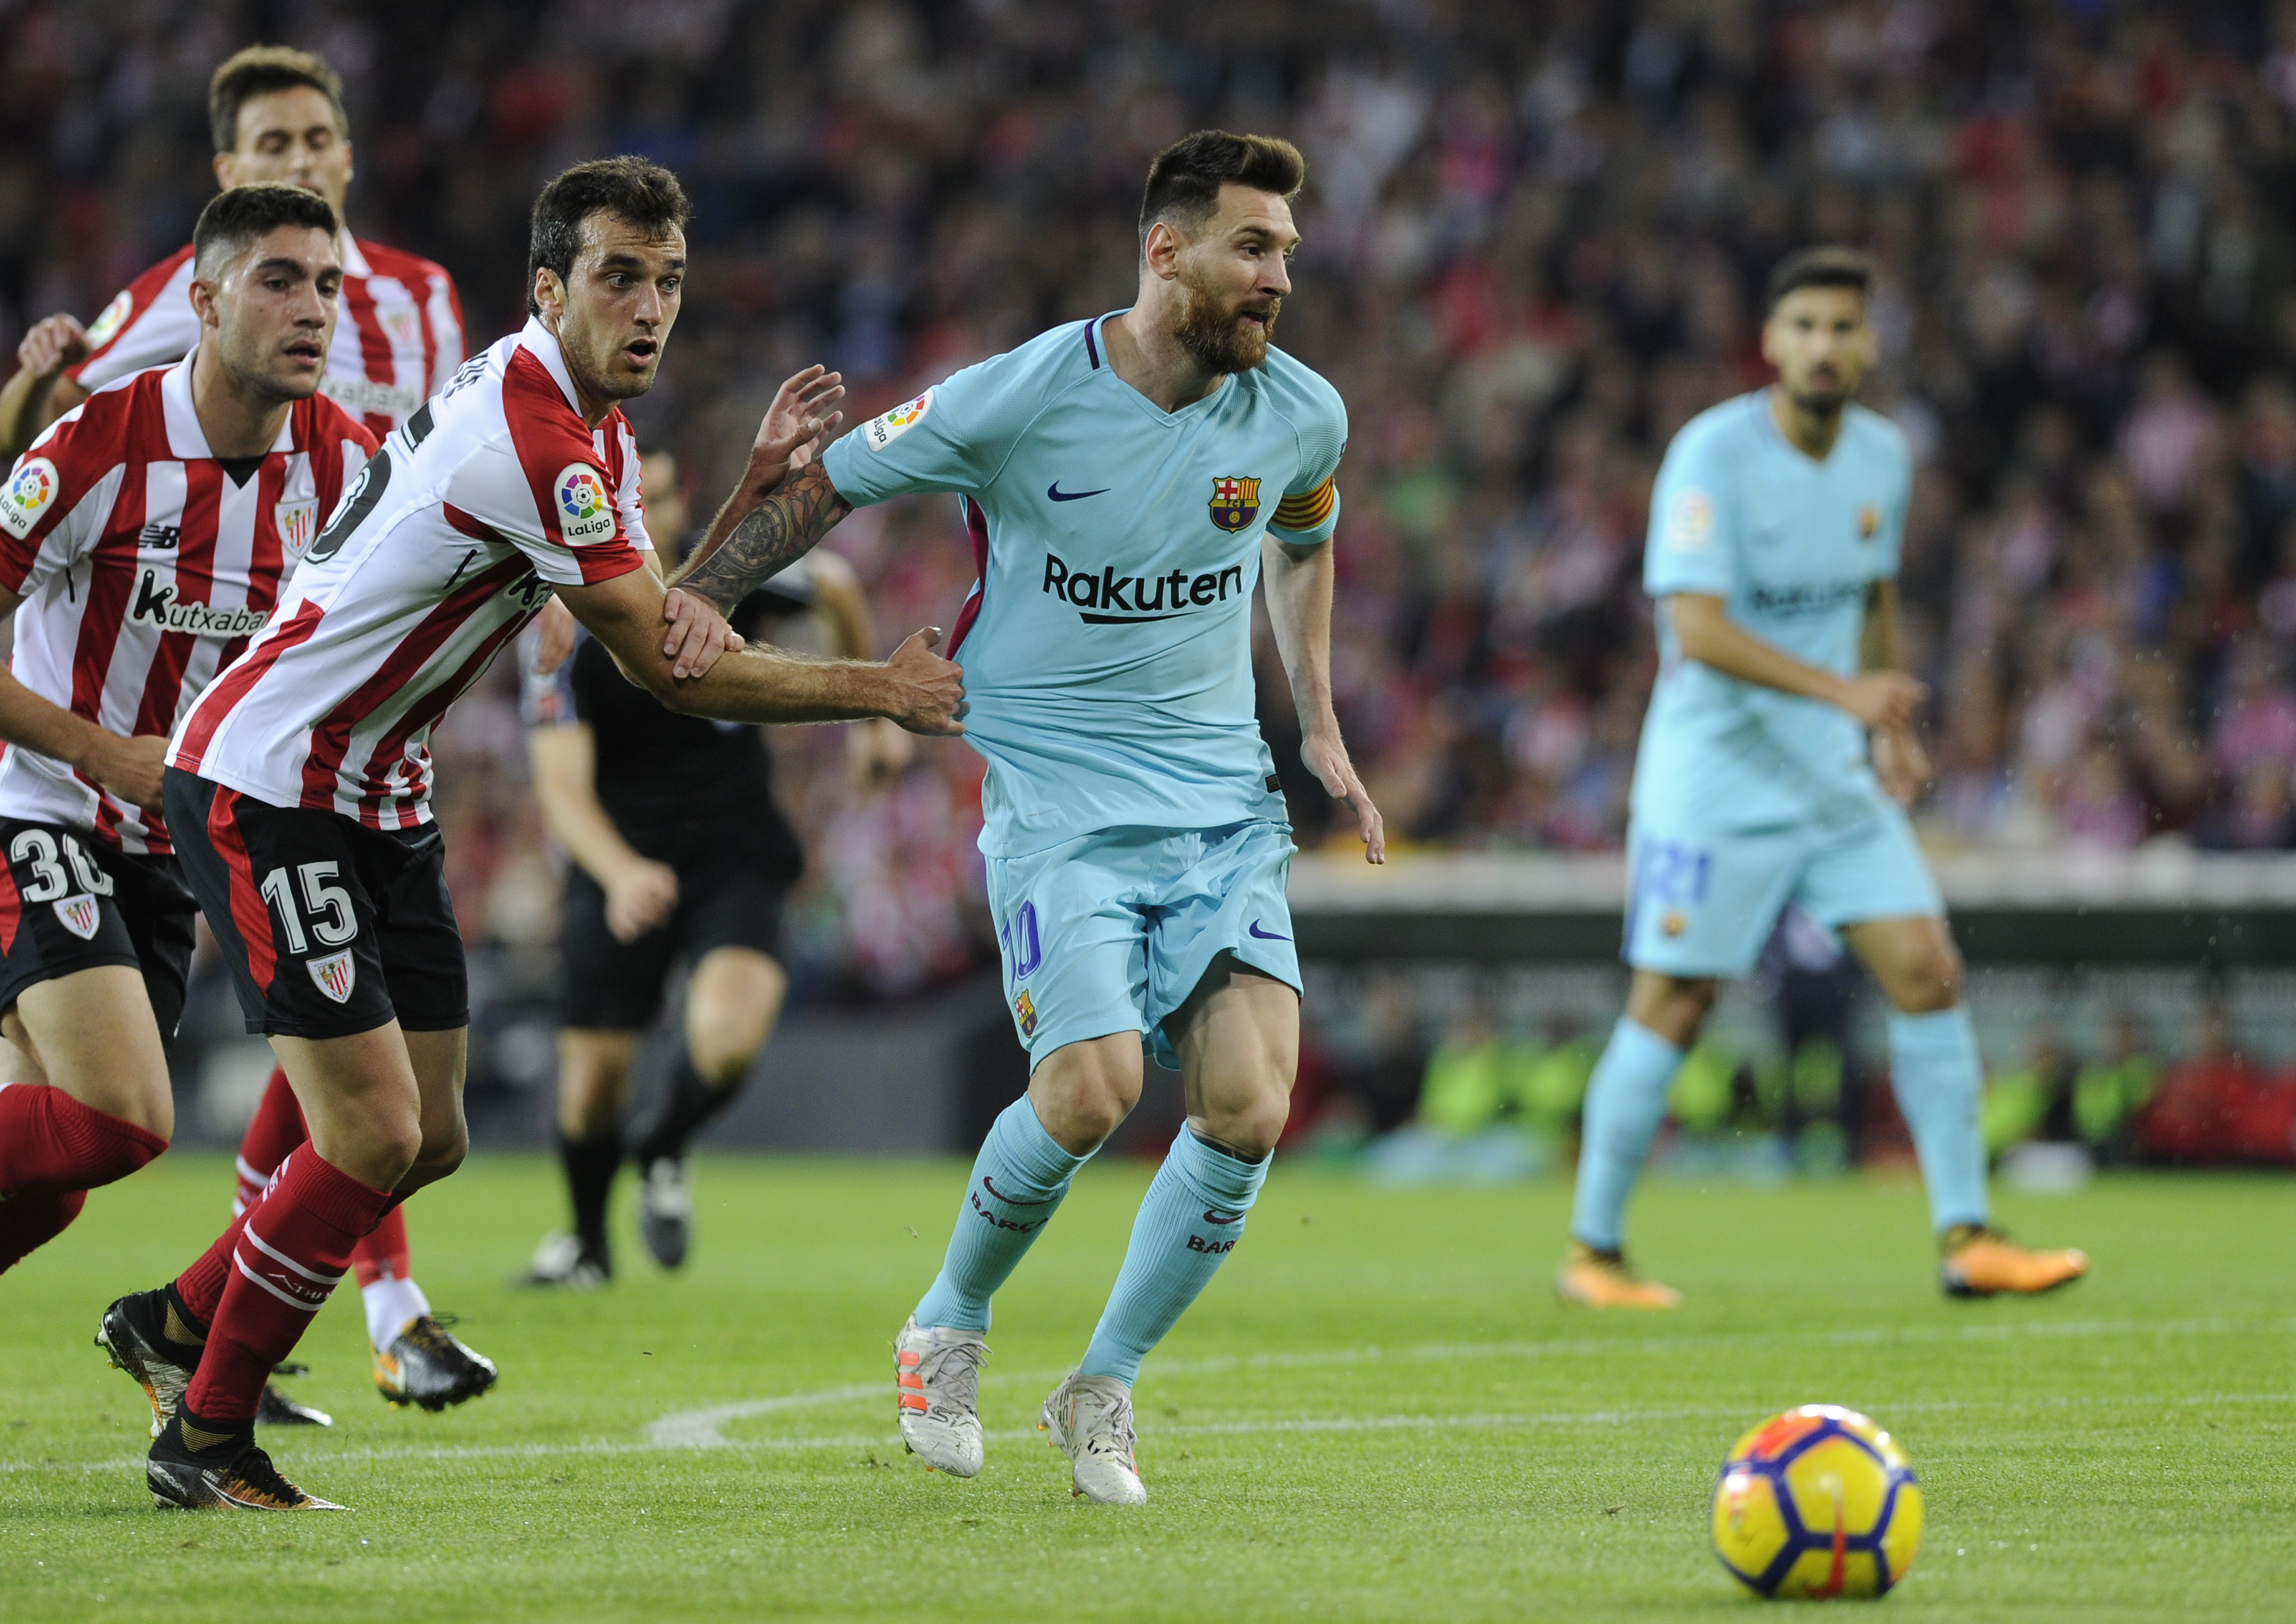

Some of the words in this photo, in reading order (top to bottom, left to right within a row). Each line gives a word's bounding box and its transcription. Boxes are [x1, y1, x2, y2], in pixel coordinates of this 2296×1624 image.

[874, 418, 887, 443] aLiga
[568, 518, 610, 536] LaLiga
[1043, 552, 1242, 611] Rakuten
[260, 861, 358, 954] 15
